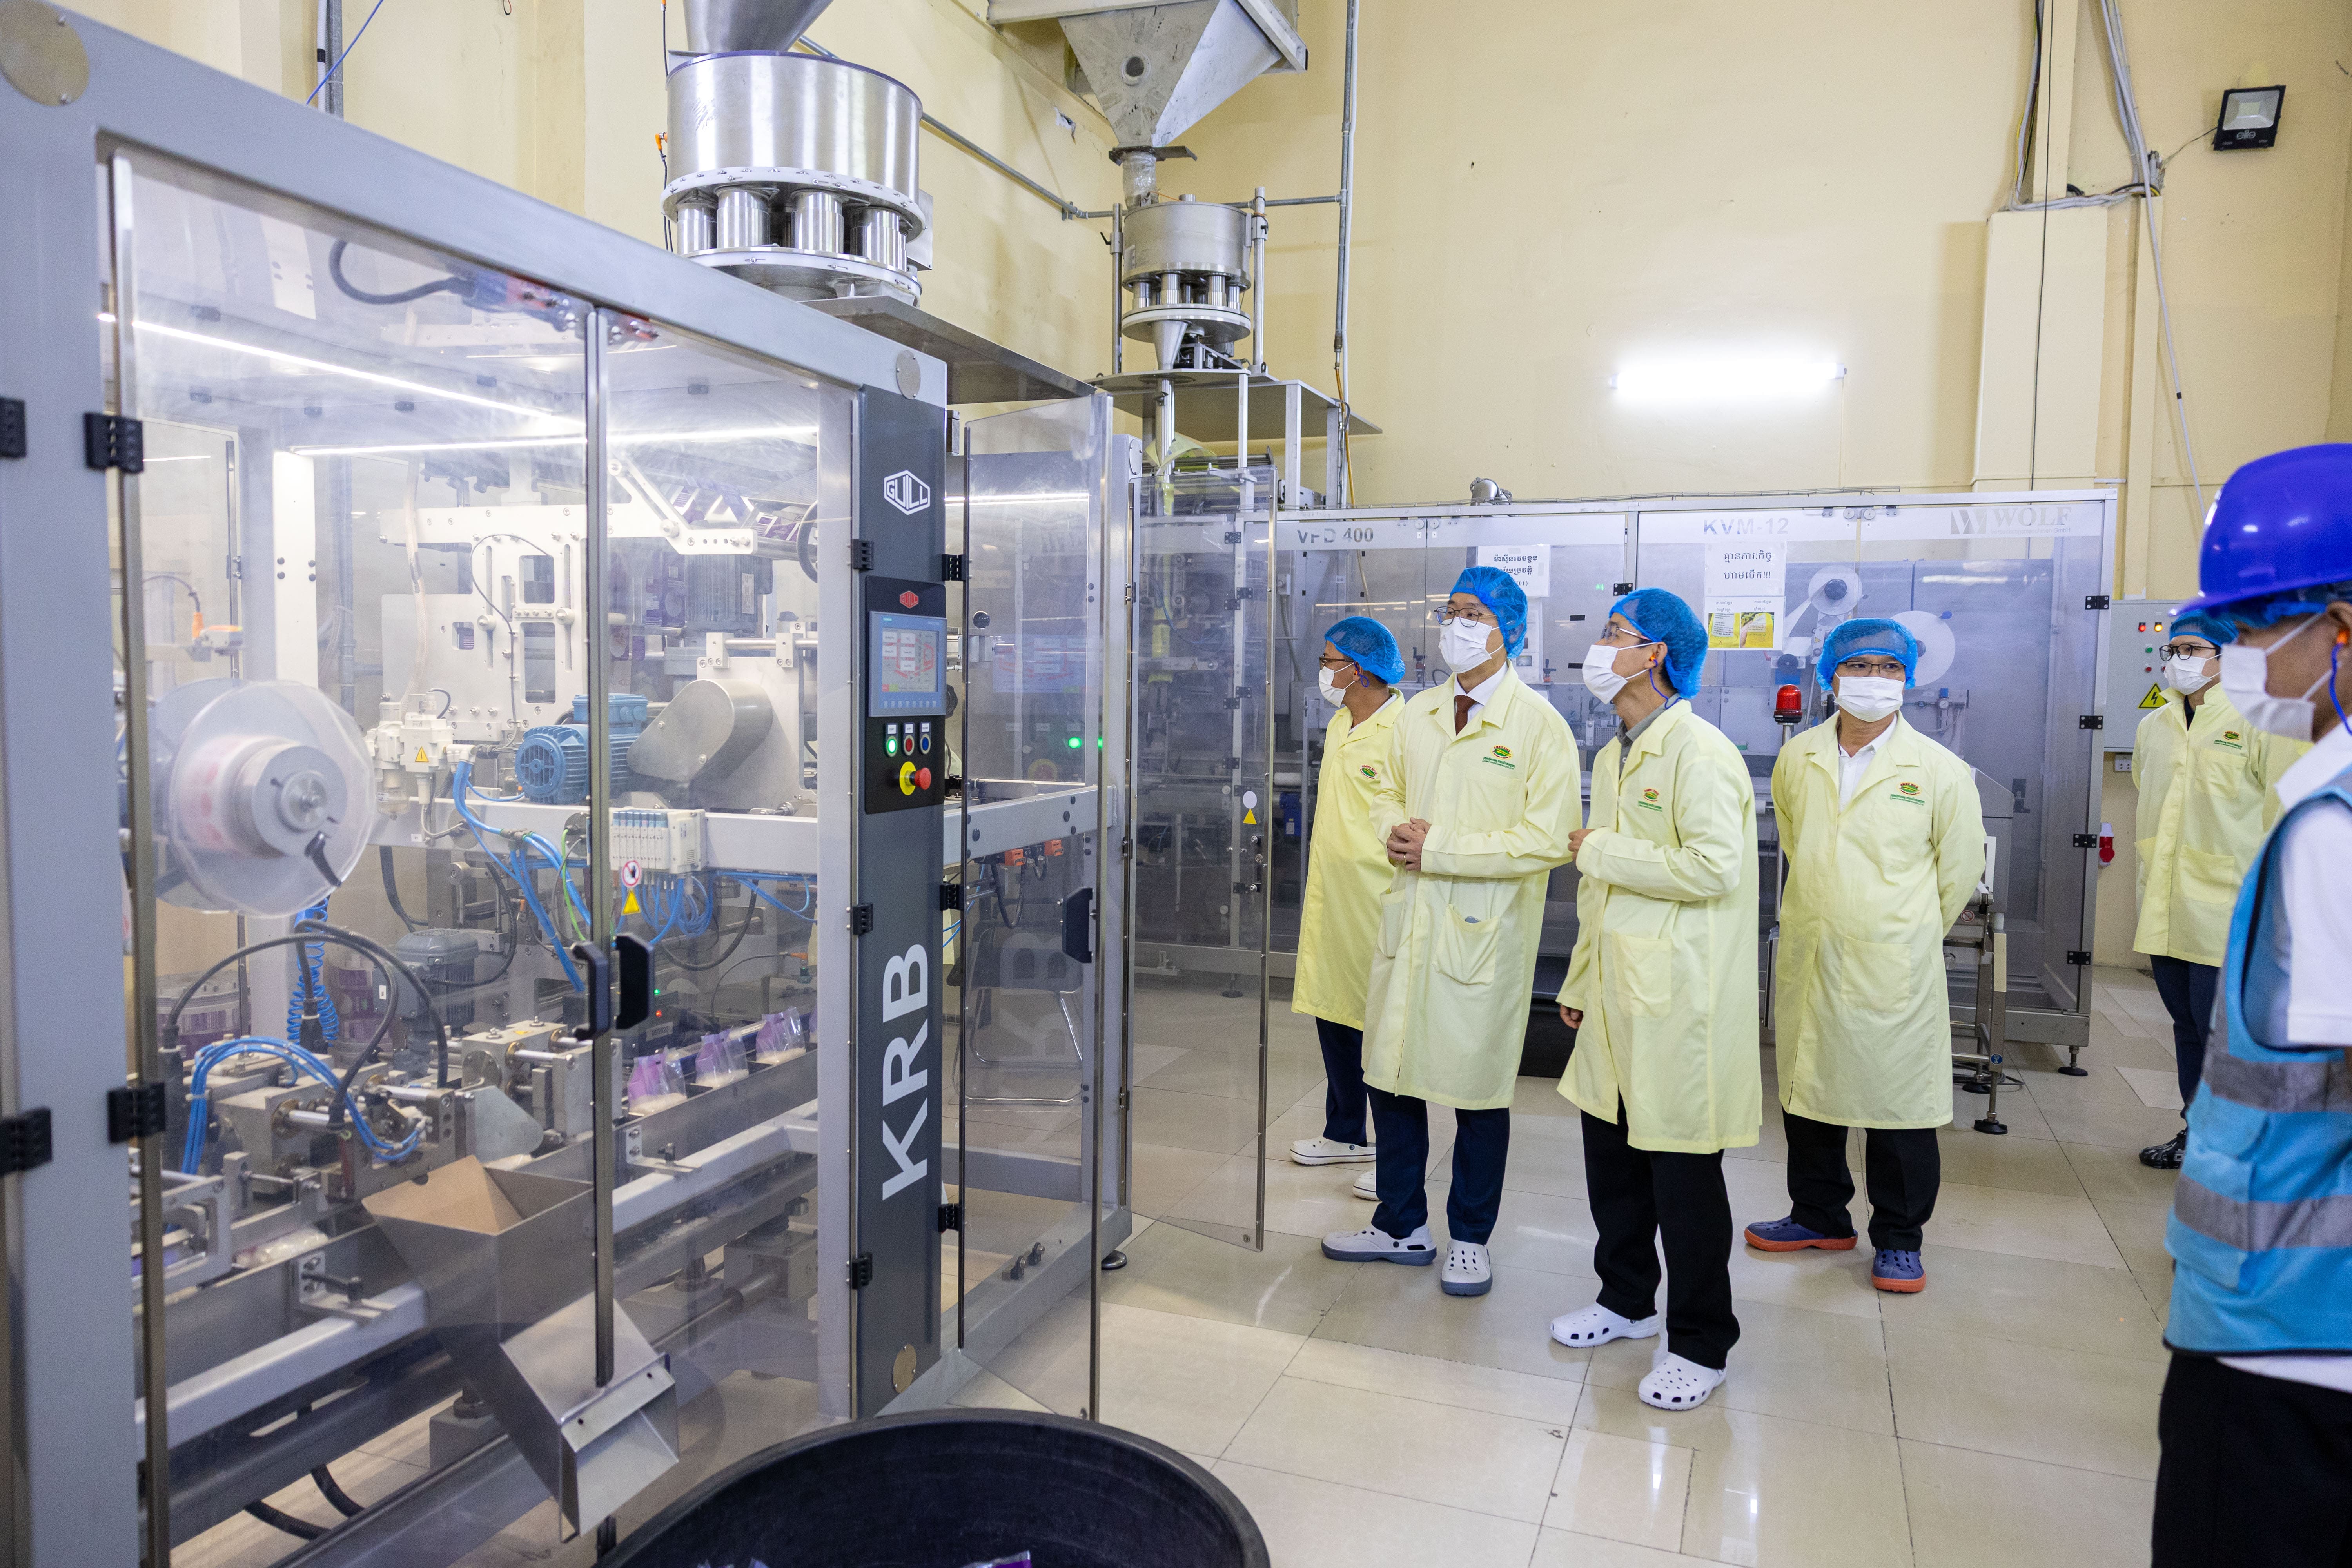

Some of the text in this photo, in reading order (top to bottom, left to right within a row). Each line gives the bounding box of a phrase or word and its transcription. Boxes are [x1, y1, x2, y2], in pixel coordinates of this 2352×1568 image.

[887, 474, 928, 510] GUILL
[1704, 518, 1789, 535] KVM-12
[1993, 506, 2072, 528] WOLF
[1342, 527, 1374, 543] 400
[883, 944, 928, 1201] KRB
